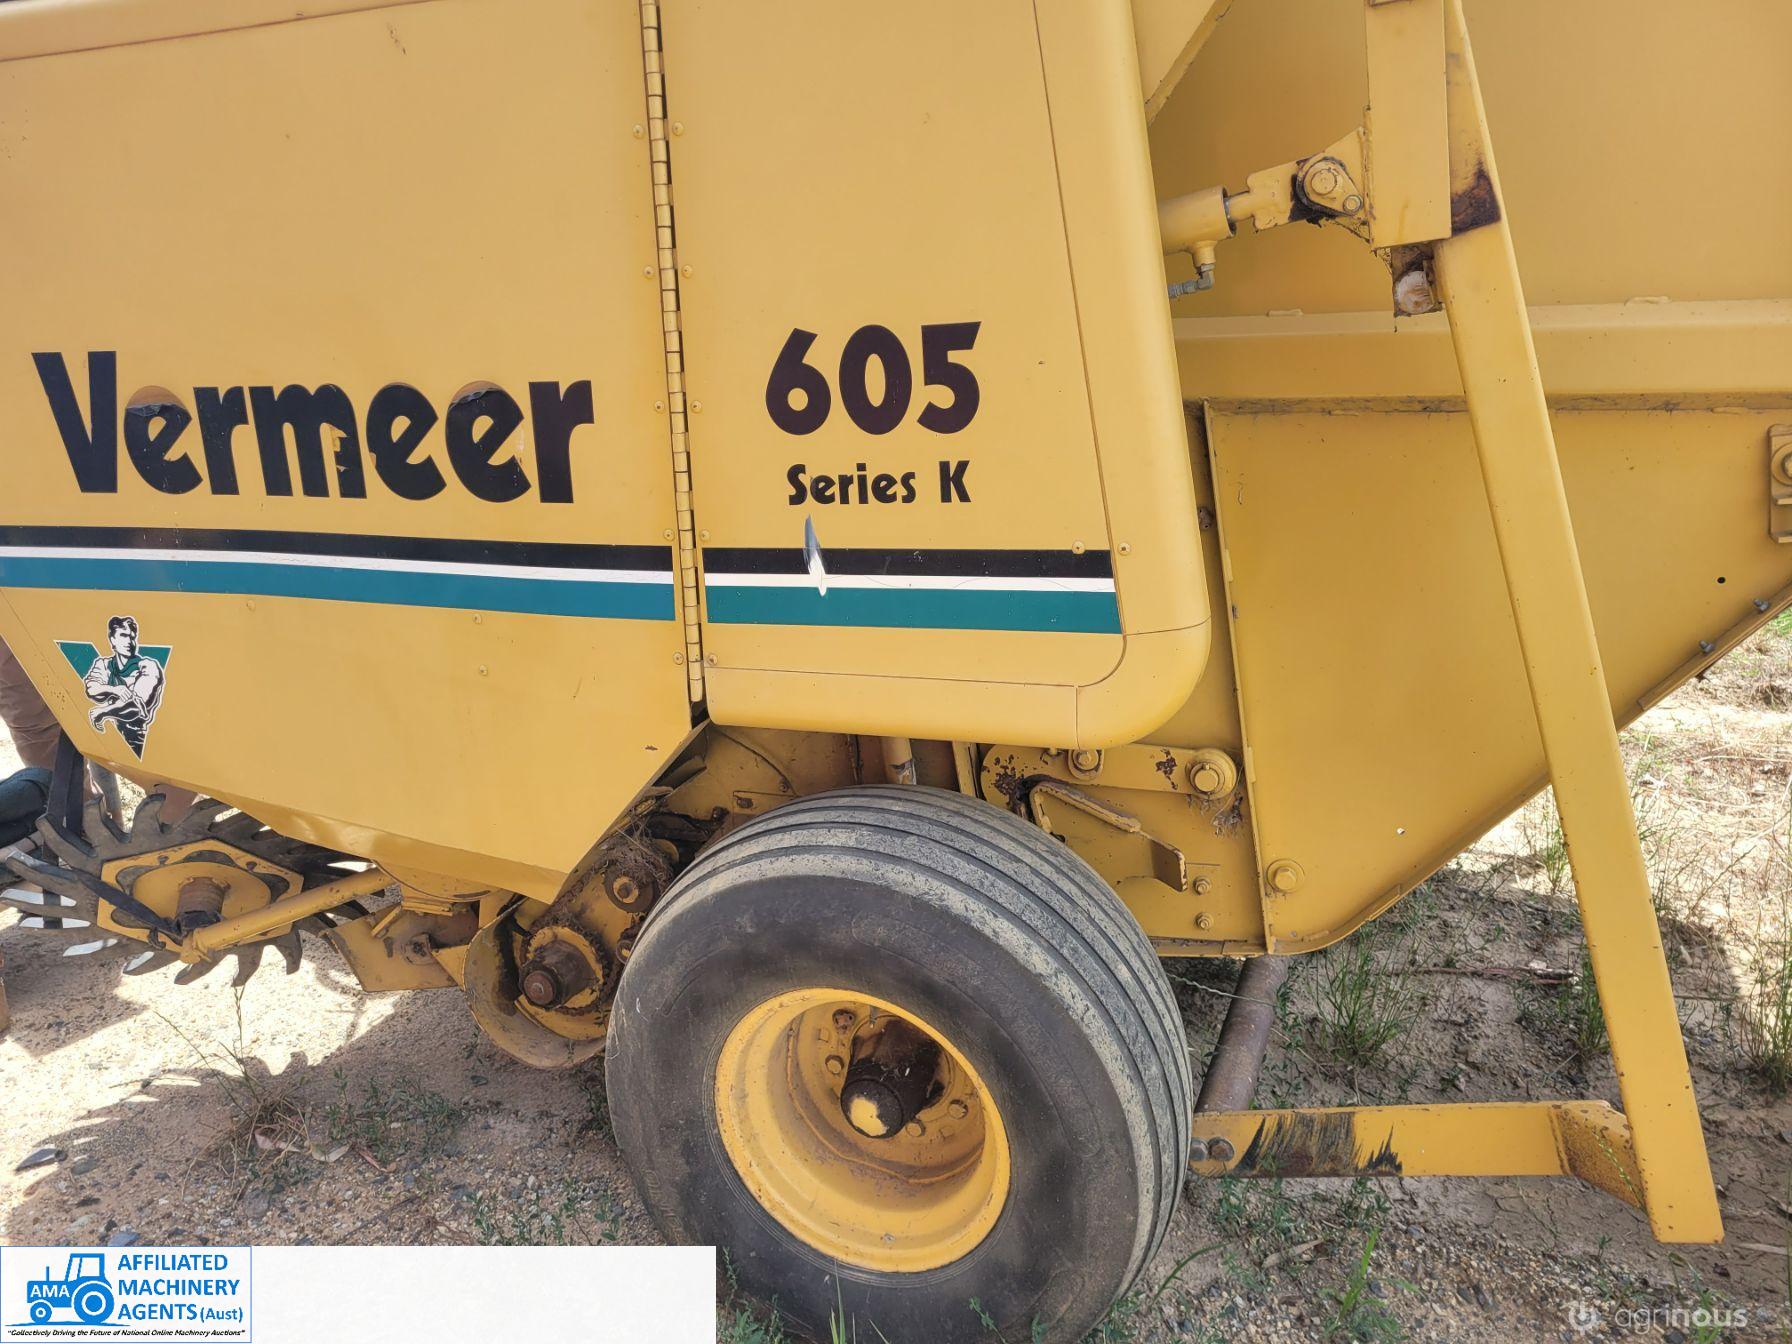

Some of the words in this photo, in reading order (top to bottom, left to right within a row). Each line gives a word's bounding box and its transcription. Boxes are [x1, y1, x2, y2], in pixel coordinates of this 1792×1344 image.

[31, 350, 595, 504] Vermeer
[766, 321, 981, 435] 605
[787, 463, 916, 506] Series
[938, 460, 972, 504] K
